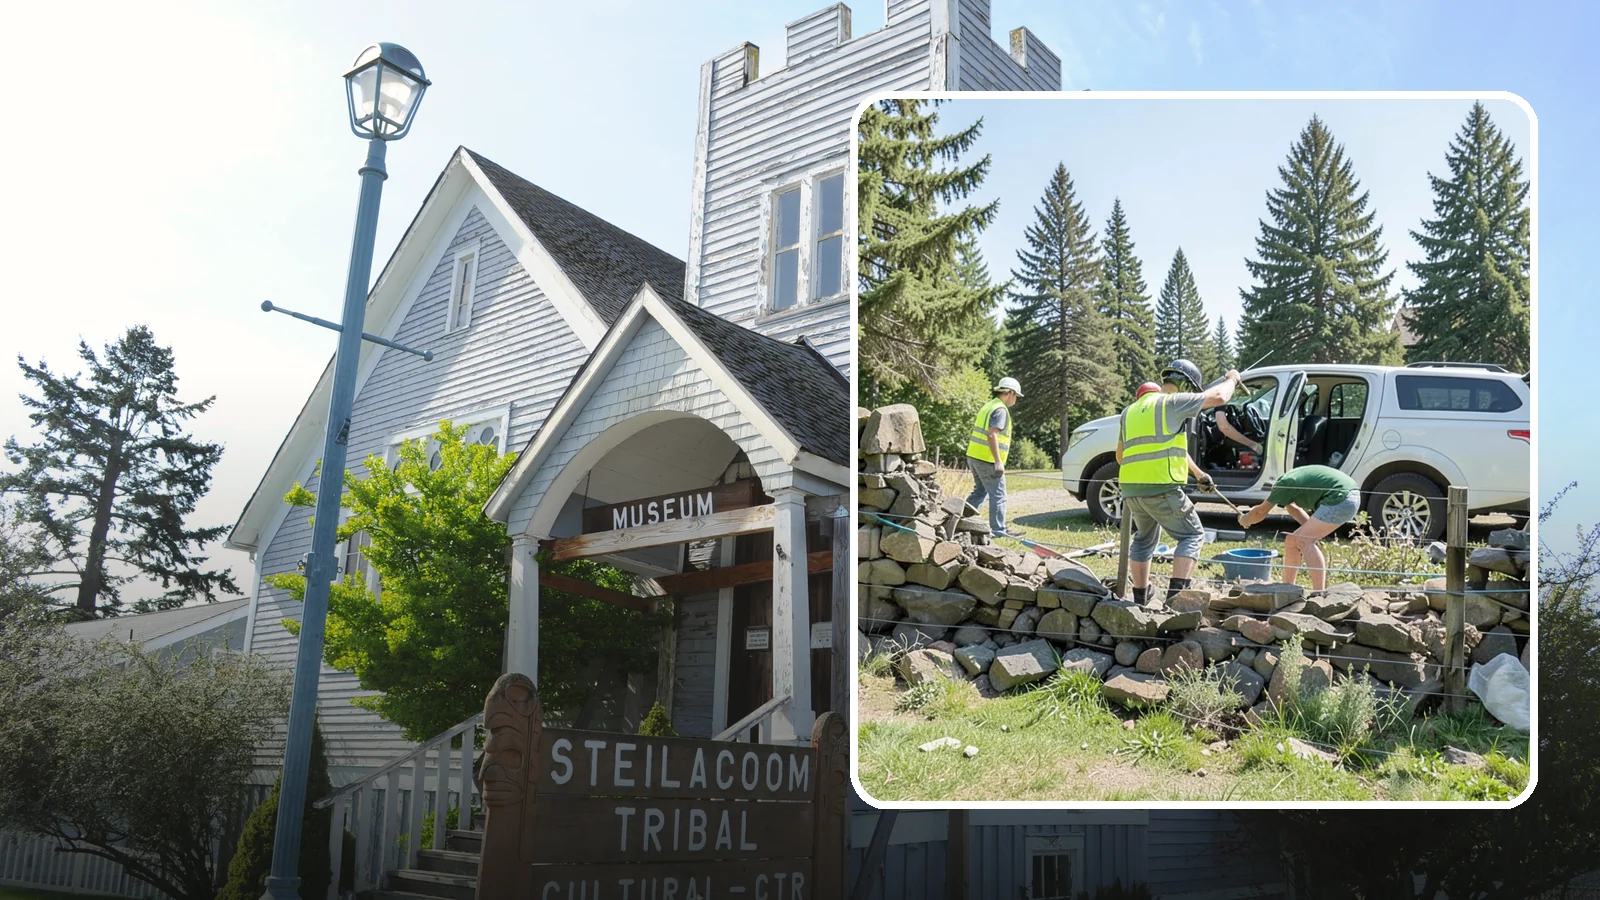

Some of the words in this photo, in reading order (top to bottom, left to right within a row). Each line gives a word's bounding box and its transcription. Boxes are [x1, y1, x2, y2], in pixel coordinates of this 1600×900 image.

[613, 491, 713, 531] MUSEUM
[550, 738, 810, 793] STEILACOOM
[615, 806, 757, 852] TRIBAL
